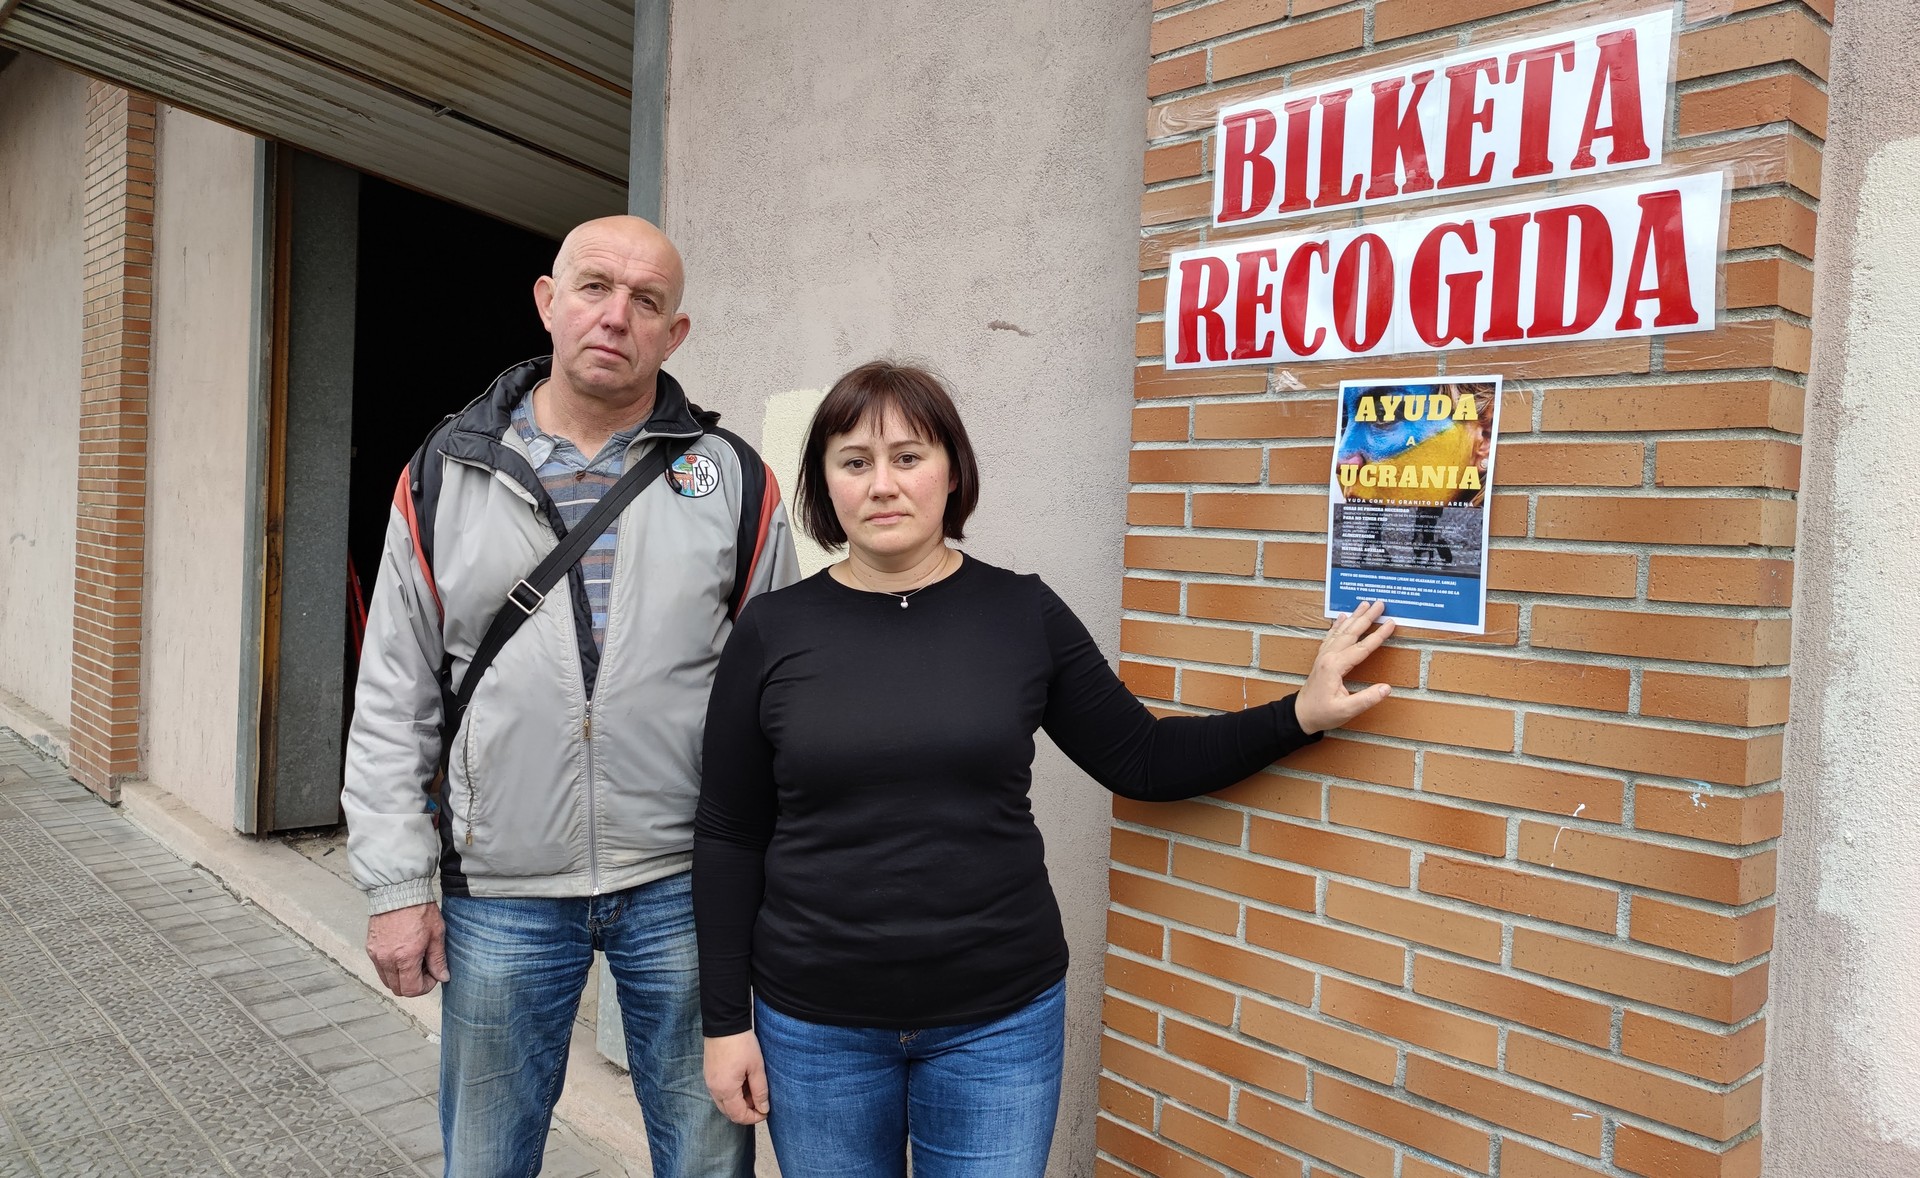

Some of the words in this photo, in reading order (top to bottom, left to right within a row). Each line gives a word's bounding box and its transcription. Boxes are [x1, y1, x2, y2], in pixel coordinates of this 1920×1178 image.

[1217, 28, 1650, 223] BILKETA
[1174, 189, 1699, 364] RECOGIDA
[1355, 394, 1479, 422] AYUDA
[1405, 435, 1416, 446] A
[1340, 464, 1482, 490] UCRANIA
